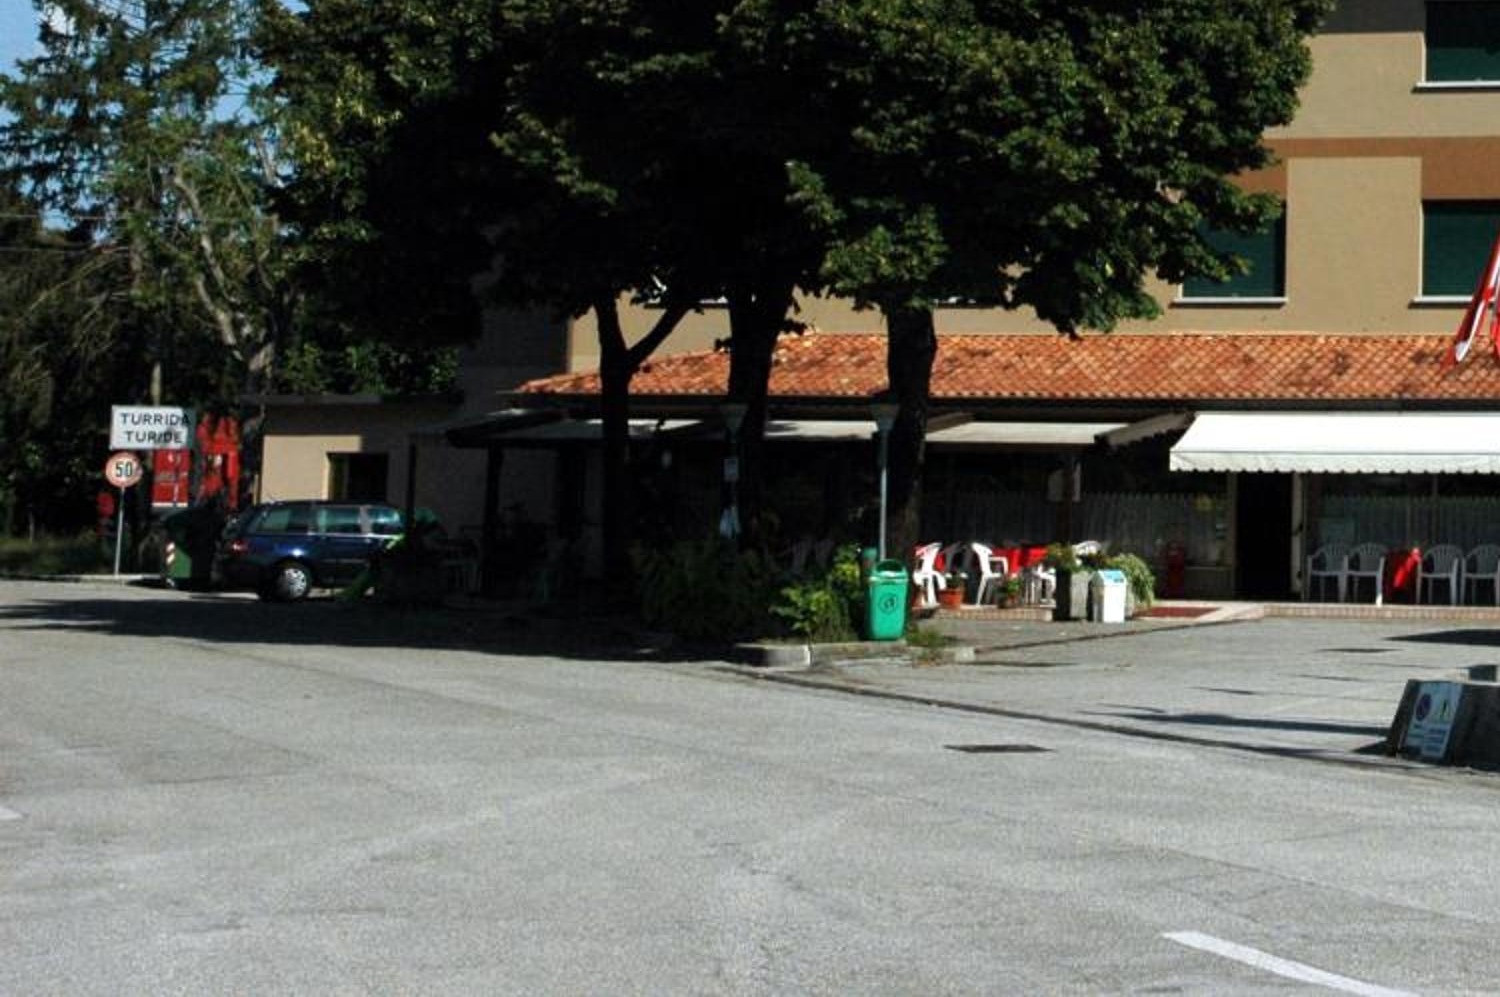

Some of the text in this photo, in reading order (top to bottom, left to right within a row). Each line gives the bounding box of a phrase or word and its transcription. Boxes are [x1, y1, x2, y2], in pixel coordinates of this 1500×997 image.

[120, 412, 190, 427] TURRIDA
[125, 430, 183, 444] TURIDE
[115, 461, 133, 478] 50
